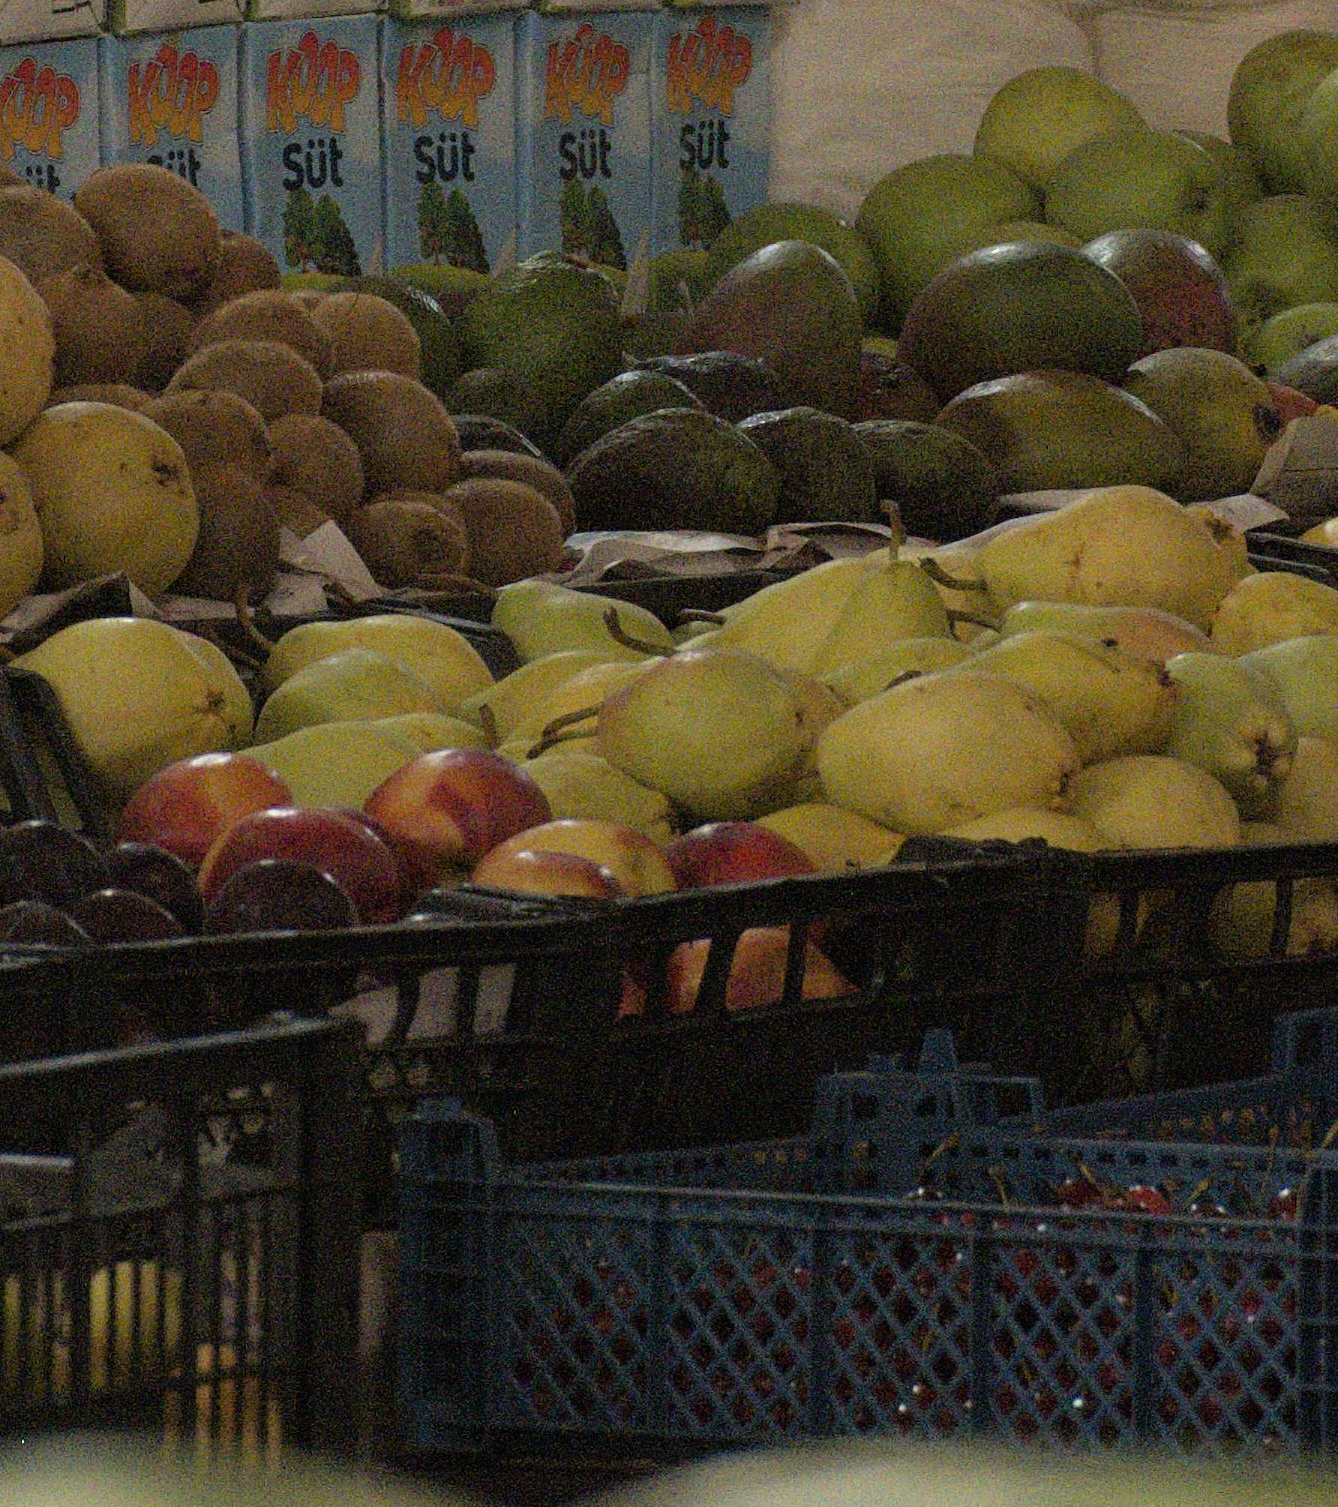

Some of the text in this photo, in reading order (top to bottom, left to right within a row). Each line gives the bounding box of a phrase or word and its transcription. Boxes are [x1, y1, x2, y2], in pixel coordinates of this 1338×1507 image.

[282, 135, 344, 191] Süt
[414, 132, 476, 184] Süt
[560, 127, 612, 180] Süt
[678, 120, 731, 171] Süt
